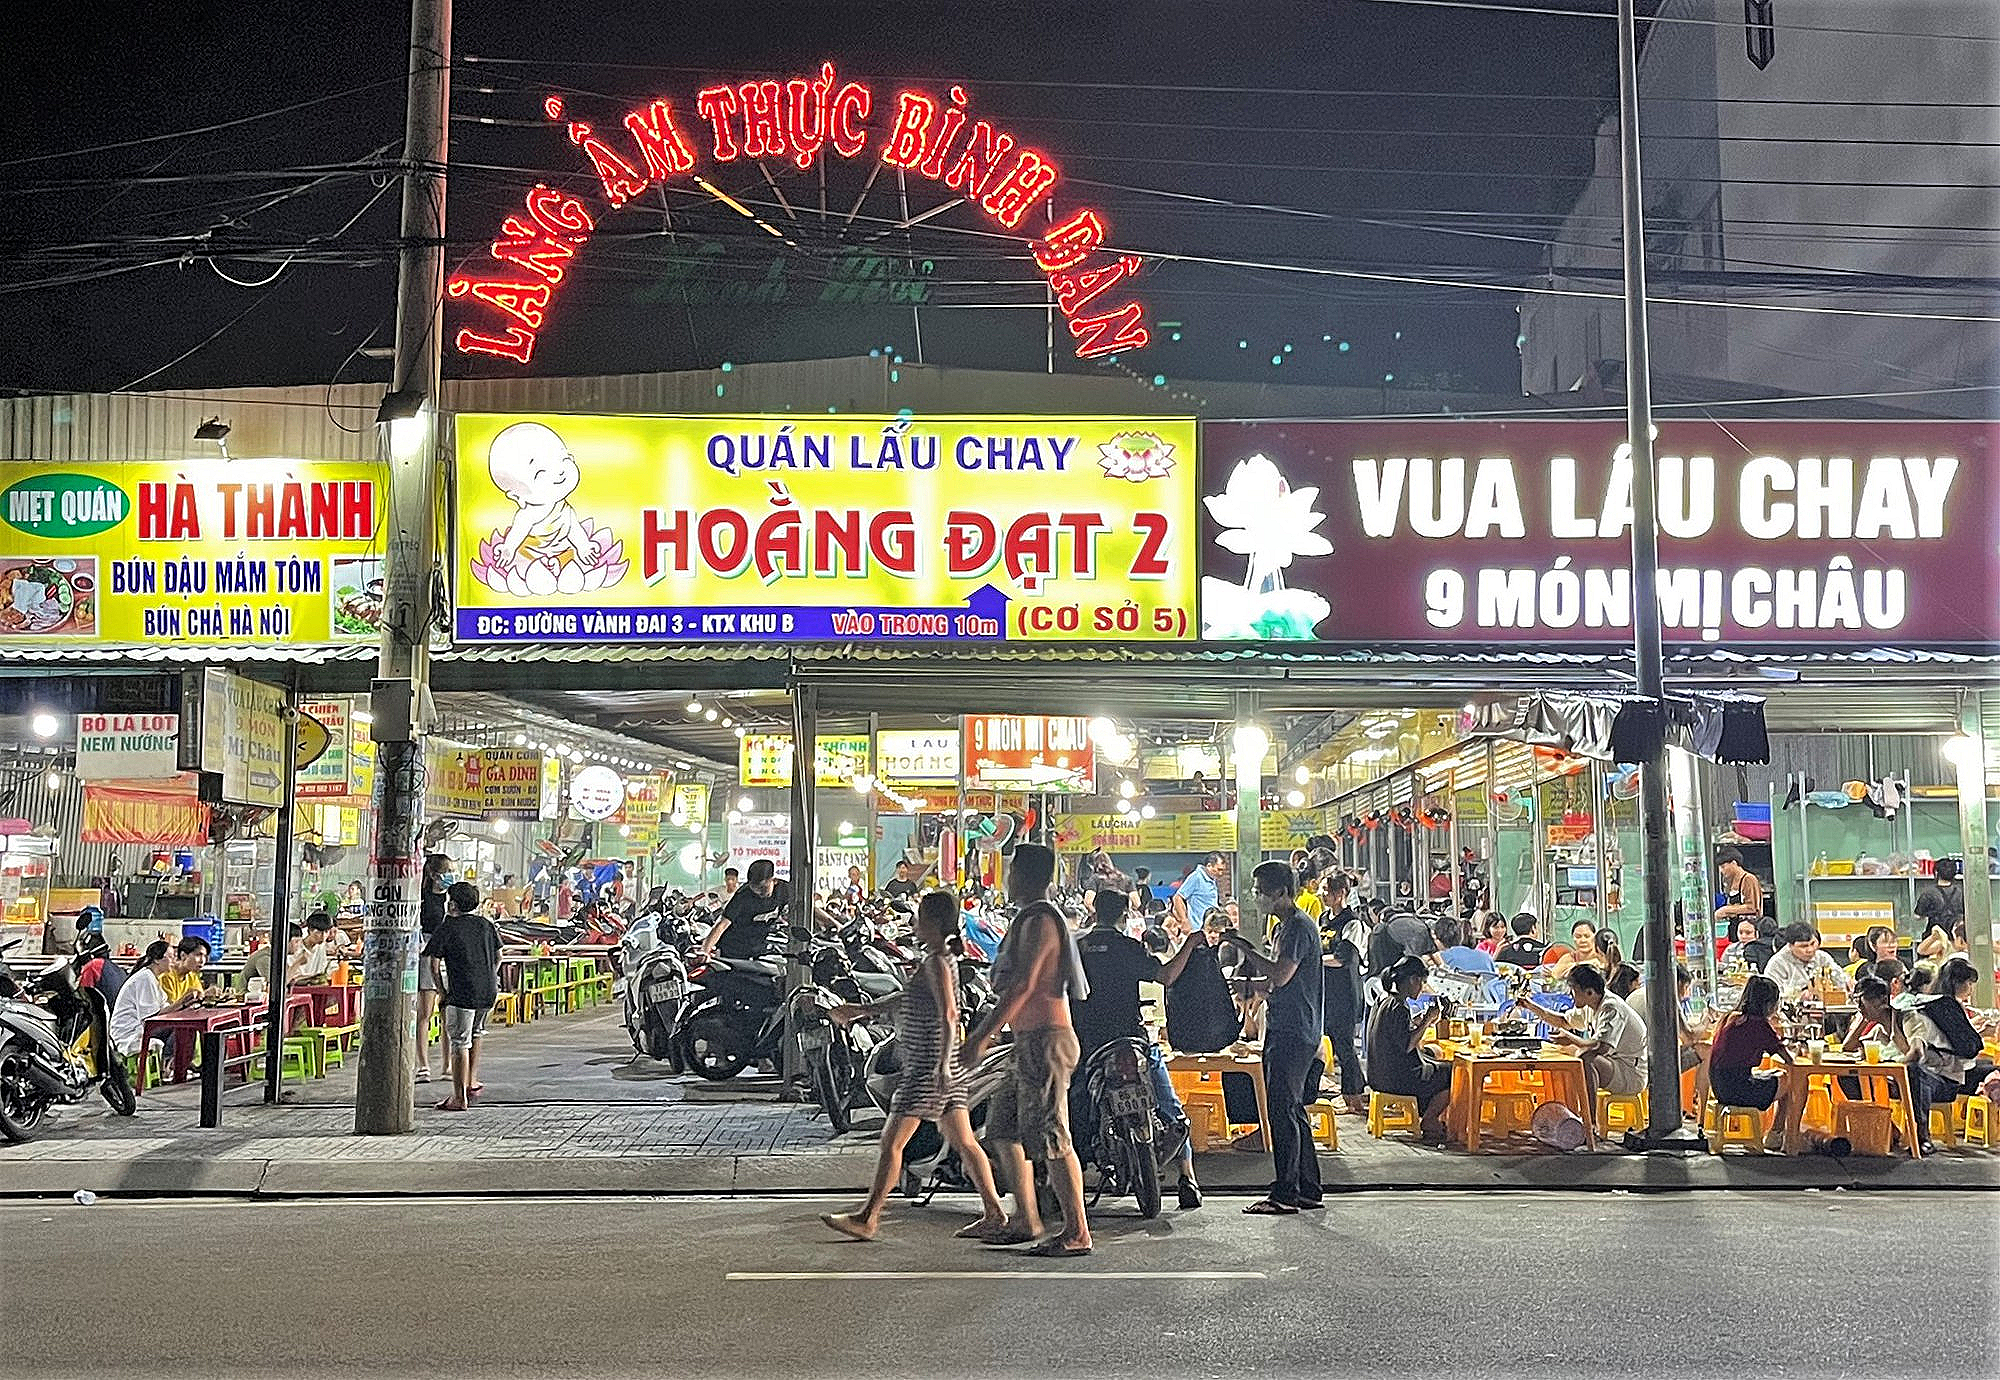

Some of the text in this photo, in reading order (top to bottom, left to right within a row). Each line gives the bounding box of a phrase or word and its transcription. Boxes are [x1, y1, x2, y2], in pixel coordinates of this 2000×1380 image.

[448, 182, 595, 364] LÀNG
[698, 61, 871, 170] THỰC
[881, 86, 1057, 228] BÌNH
[707, 425, 834, 475] QUÁN
[956, 436, 1077, 471] CHAY
[9, 484, 122, 528] MẸT QUÁN
[138, 473, 374, 539] HÀ THÀNH
[1351, 457, 1526, 539] VUA
[1739, 456, 1961, 540] CHAY
[944, 511, 1105, 591] ĐẠT
[1132, 512, 1170, 575] 2
[112, 551, 321, 600] BÚN ĐẬU MẮM TÔM
[1424, 555, 1907, 642] 9 MÓN MỊ CHÂU
[144, 602, 290, 641] BÚN CHẢ HÀ NỘI
[477, 615, 509, 635] ĐC:
[514, 610, 577, 634] ĐƯỜNG
[582, 611, 631, 634] VÀNH
[635, 614, 667, 633] ĐAI
[671, 614, 684, 633] 3
[702, 614, 736, 633] KTX
[740, 614, 776, 633] KHU
[781, 614, 795, 633] B
[833, 609, 998, 636] VÀO TRONG 10m
[1018, 599, 1187, 638] (CƠ SỞ 5)
[81, 737, 116, 752] NEM
[975, 718, 984, 751] 9
